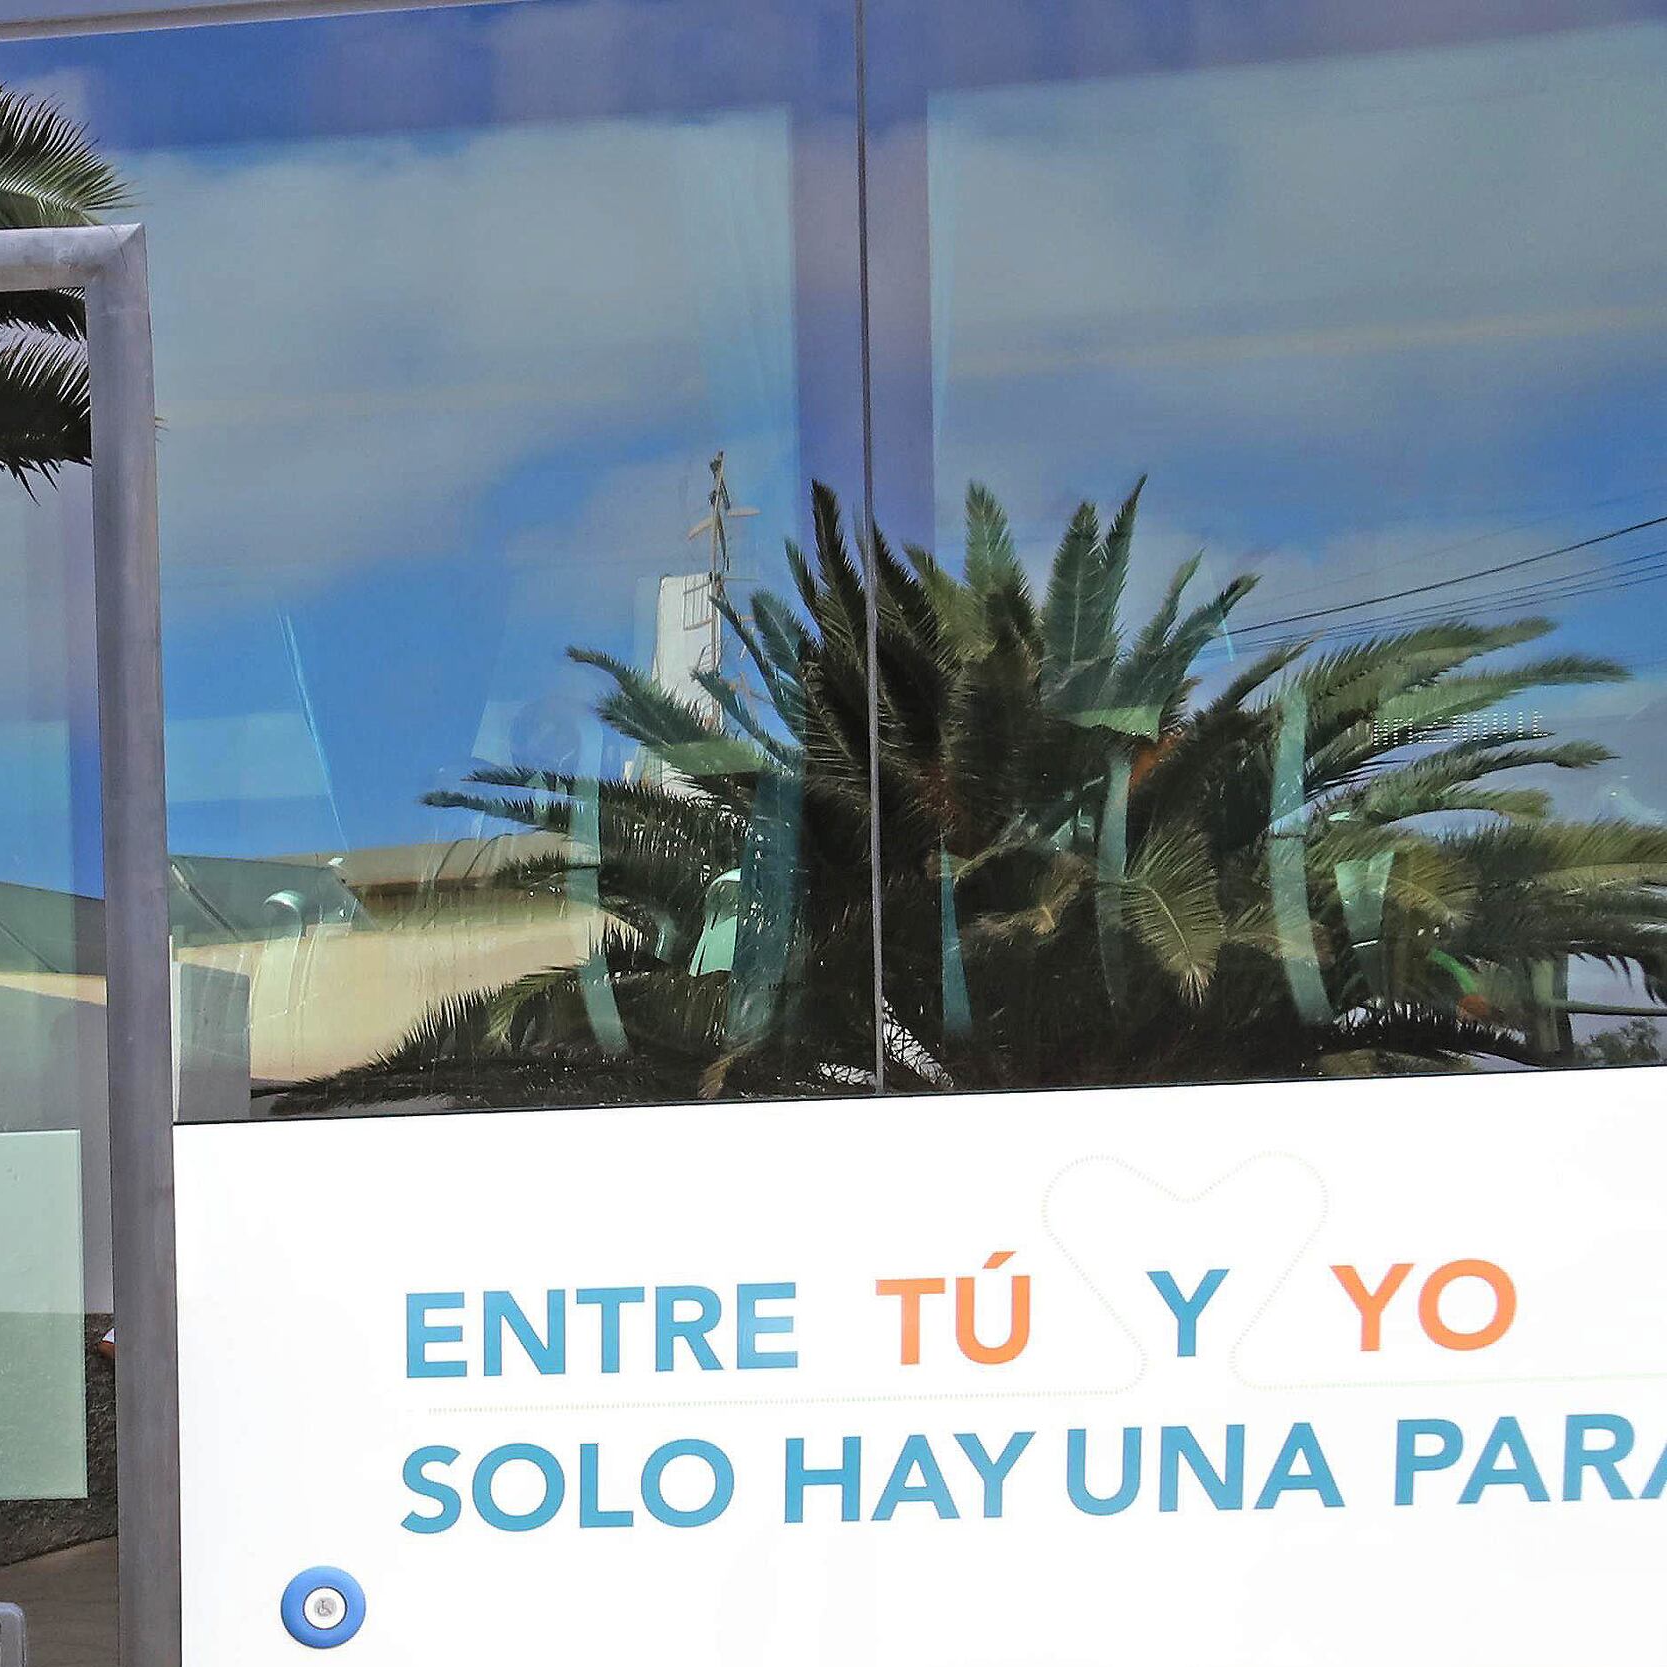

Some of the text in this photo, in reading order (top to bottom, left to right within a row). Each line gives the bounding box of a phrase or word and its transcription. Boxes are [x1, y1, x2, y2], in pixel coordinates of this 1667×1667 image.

[404, 1250, 1518, 1379] ENTRE TÚ Y YO
[400, 1438, 736, 1534] SOLO
[783, 1431, 1036, 1525] HAY
[1066, 1421, 1345, 1517] UNA
